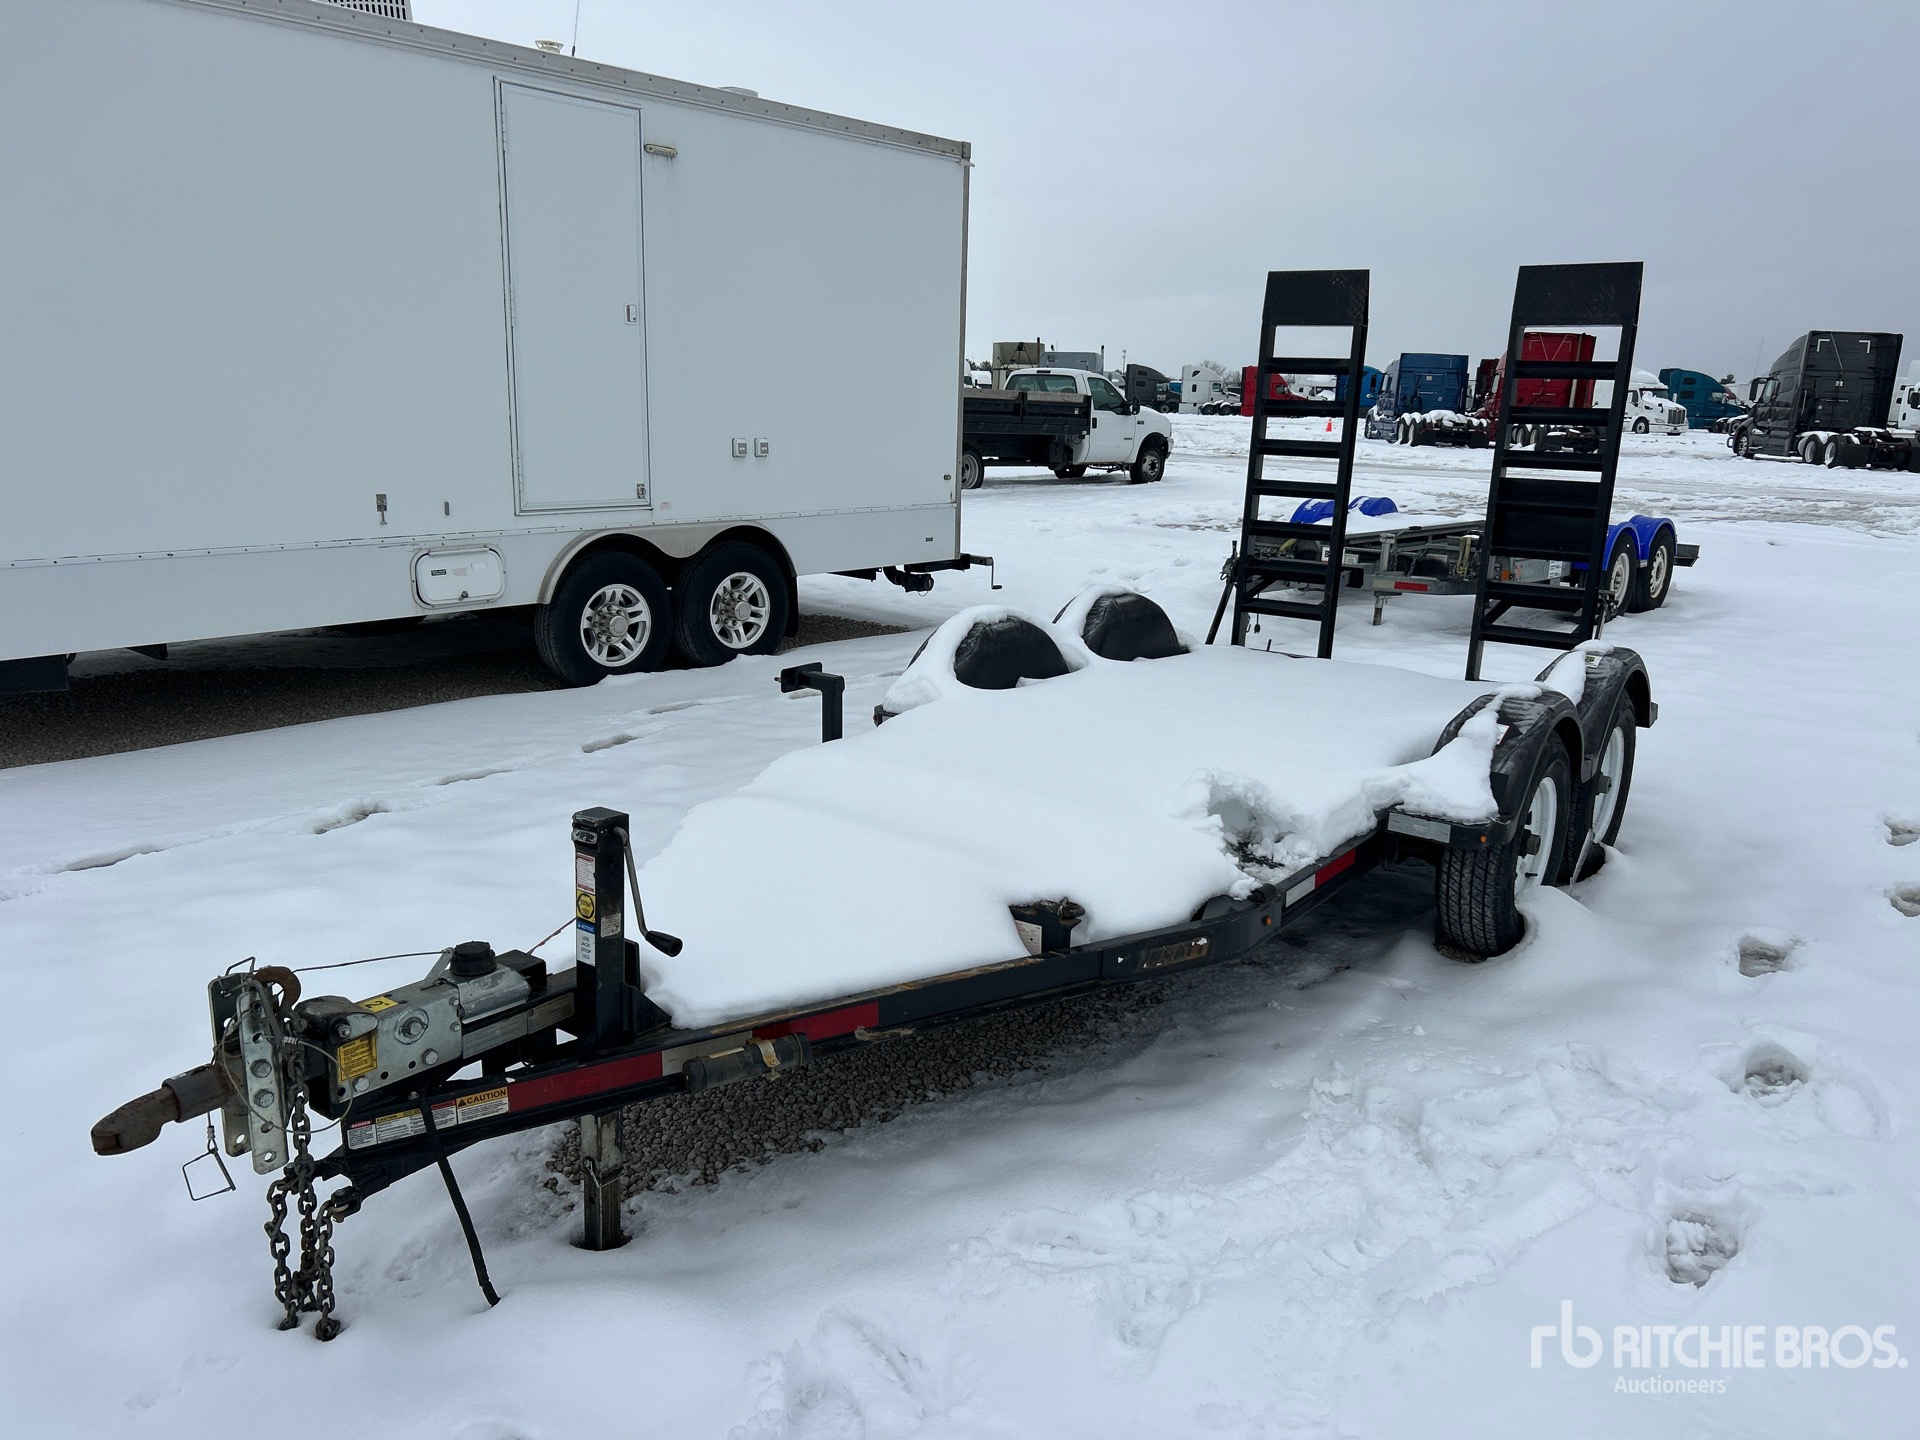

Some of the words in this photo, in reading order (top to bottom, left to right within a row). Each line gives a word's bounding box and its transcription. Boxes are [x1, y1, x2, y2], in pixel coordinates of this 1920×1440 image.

[466, 1089, 507, 1105] CAUTION
[377, 1114, 398, 1123] CAUTION
[350, 1120, 371, 1128] DANGER
